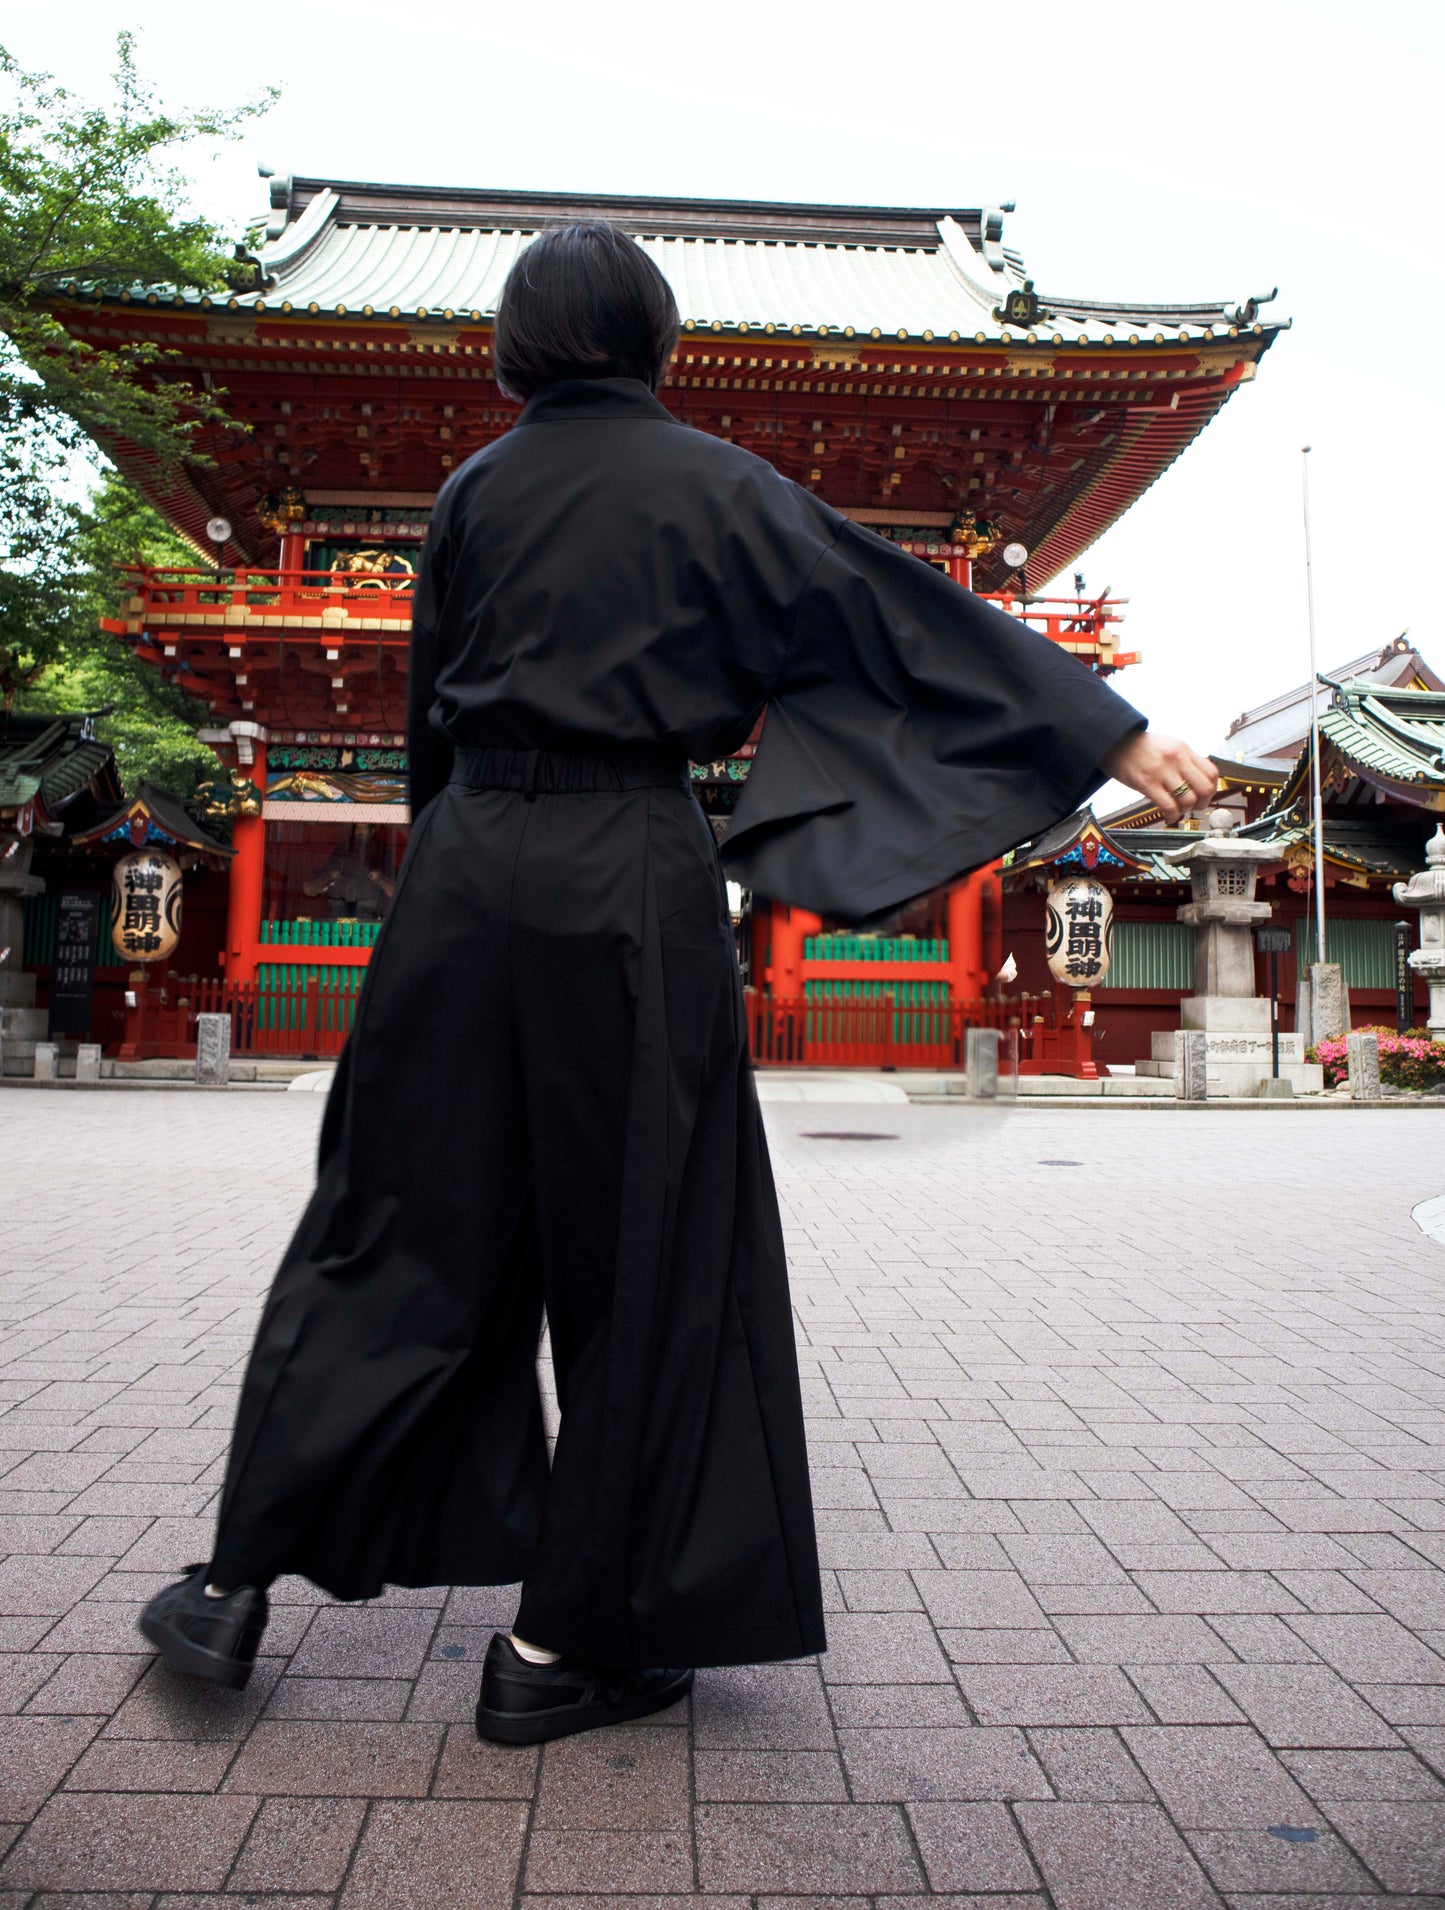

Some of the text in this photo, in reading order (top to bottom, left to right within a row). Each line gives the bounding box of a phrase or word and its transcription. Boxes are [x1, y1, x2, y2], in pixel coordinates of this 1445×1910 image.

[122, 868, 163, 953] 神田明神
[1065, 897, 1103, 978] 神田明神
